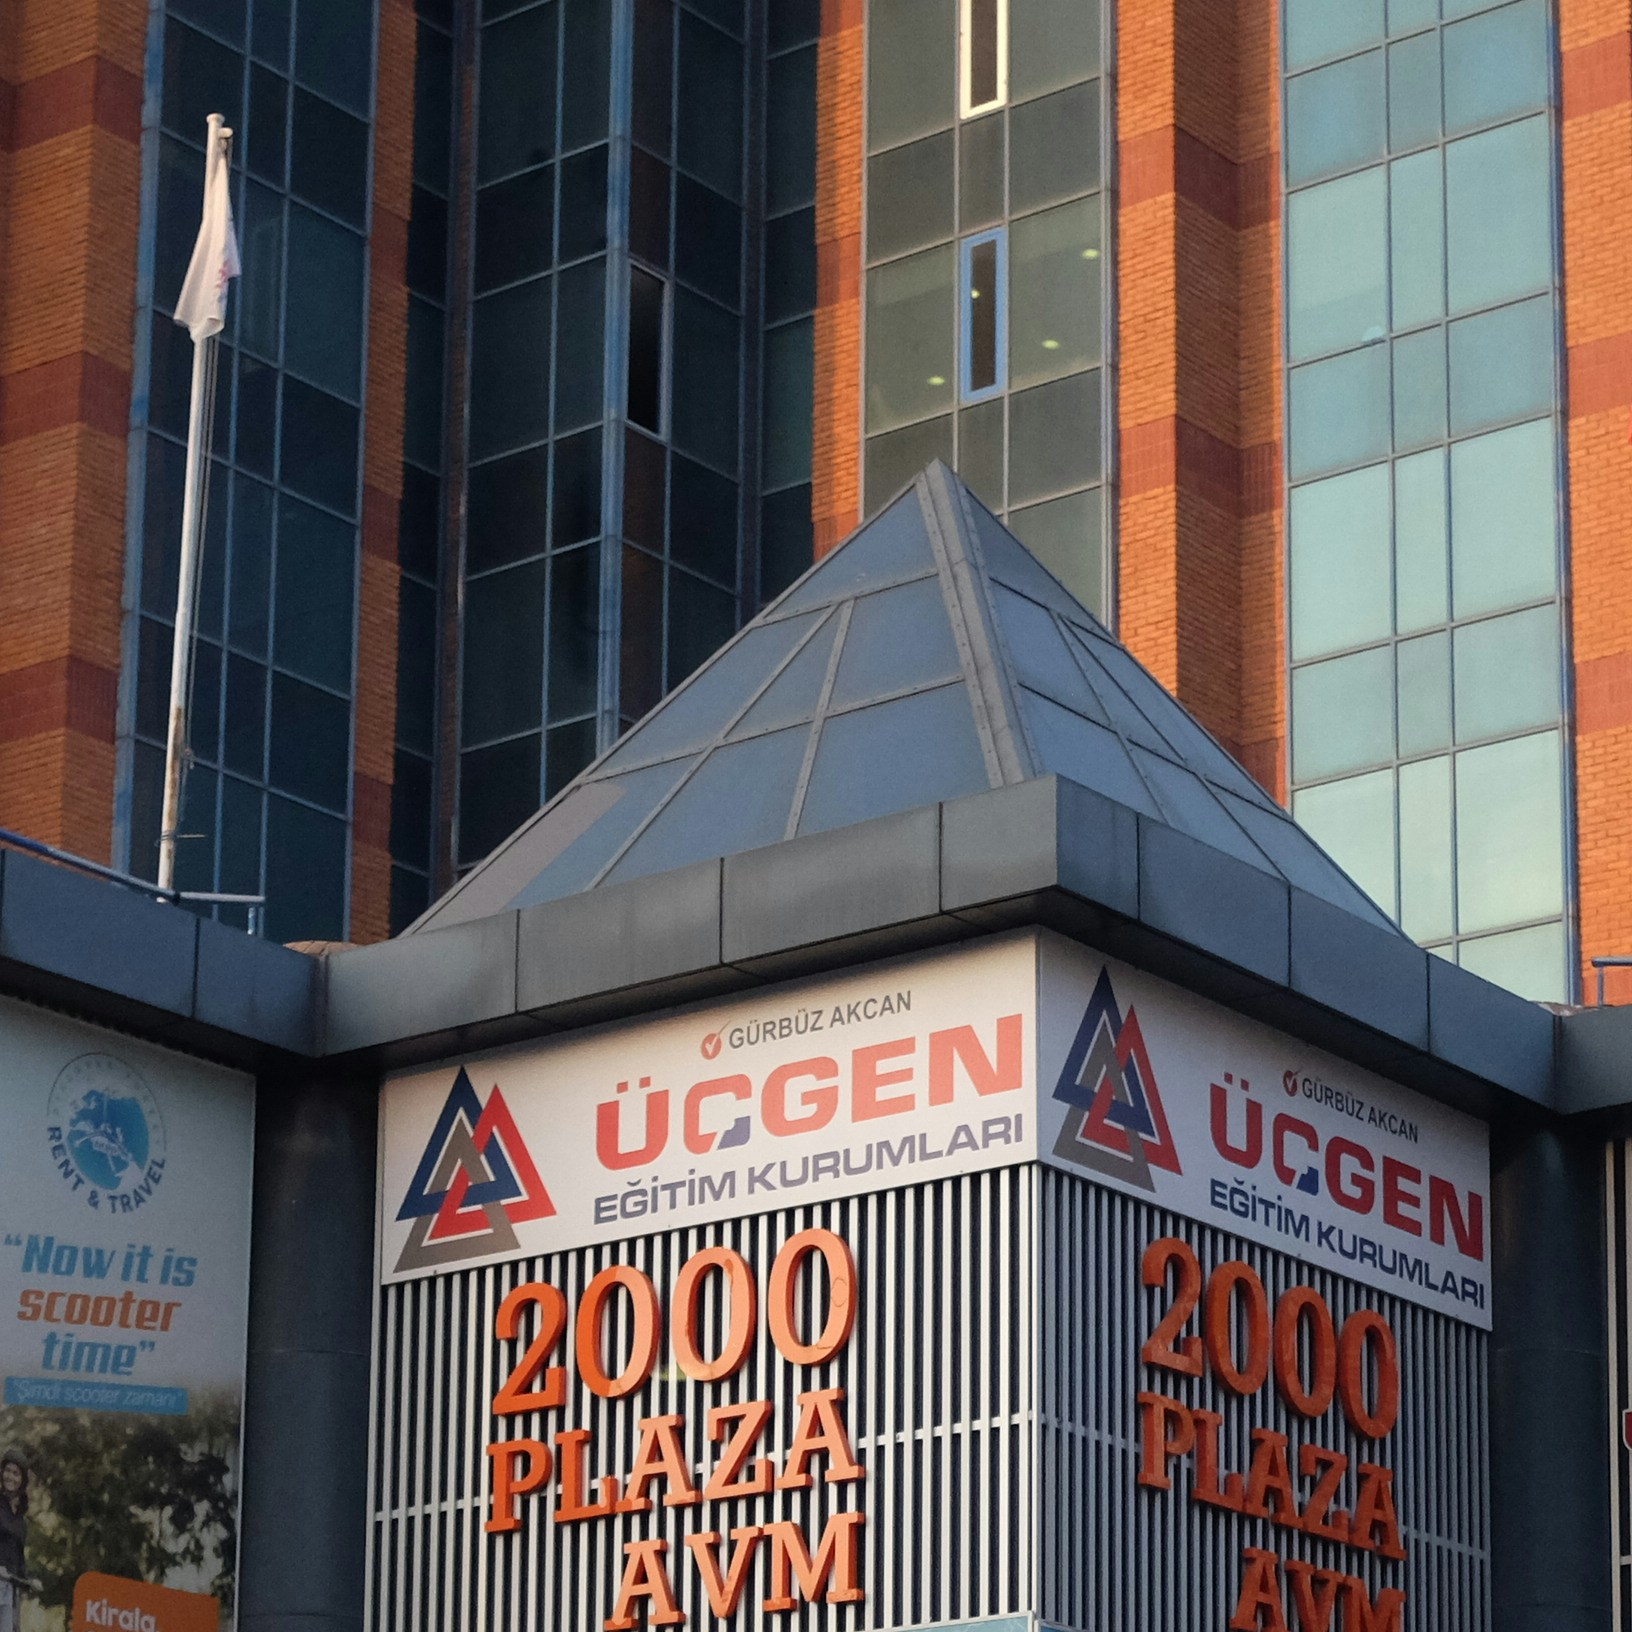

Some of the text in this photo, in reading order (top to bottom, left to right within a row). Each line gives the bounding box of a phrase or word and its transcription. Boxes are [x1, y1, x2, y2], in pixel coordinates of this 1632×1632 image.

[727, 990, 913, 1051] GÜRBÜZ AKCAN
[1301, 1076, 1420, 1144] GÜRBÜZ AKCAN
[47, 1126, 166, 1213] RENT & TRAVEL
[593, 1112, 1024, 1226] EĞİTİM KURUMLARI
[121, 1242, 154, 1284] it
[159, 1247, 198, 1287] is
[1210, 1177, 1485, 1310] EĞİTİM KURUMLARI
[16, 1288, 183, 1332] scooter
[491, 1227, 858, 1418] 2000
[1141, 1237, 1400, 1440] 2000
[484, 1388, 866, 1533] PLAZA
[1137, 1391, 1408, 1562] PLAZA
[603, 1511, 866, 1632] AVM
